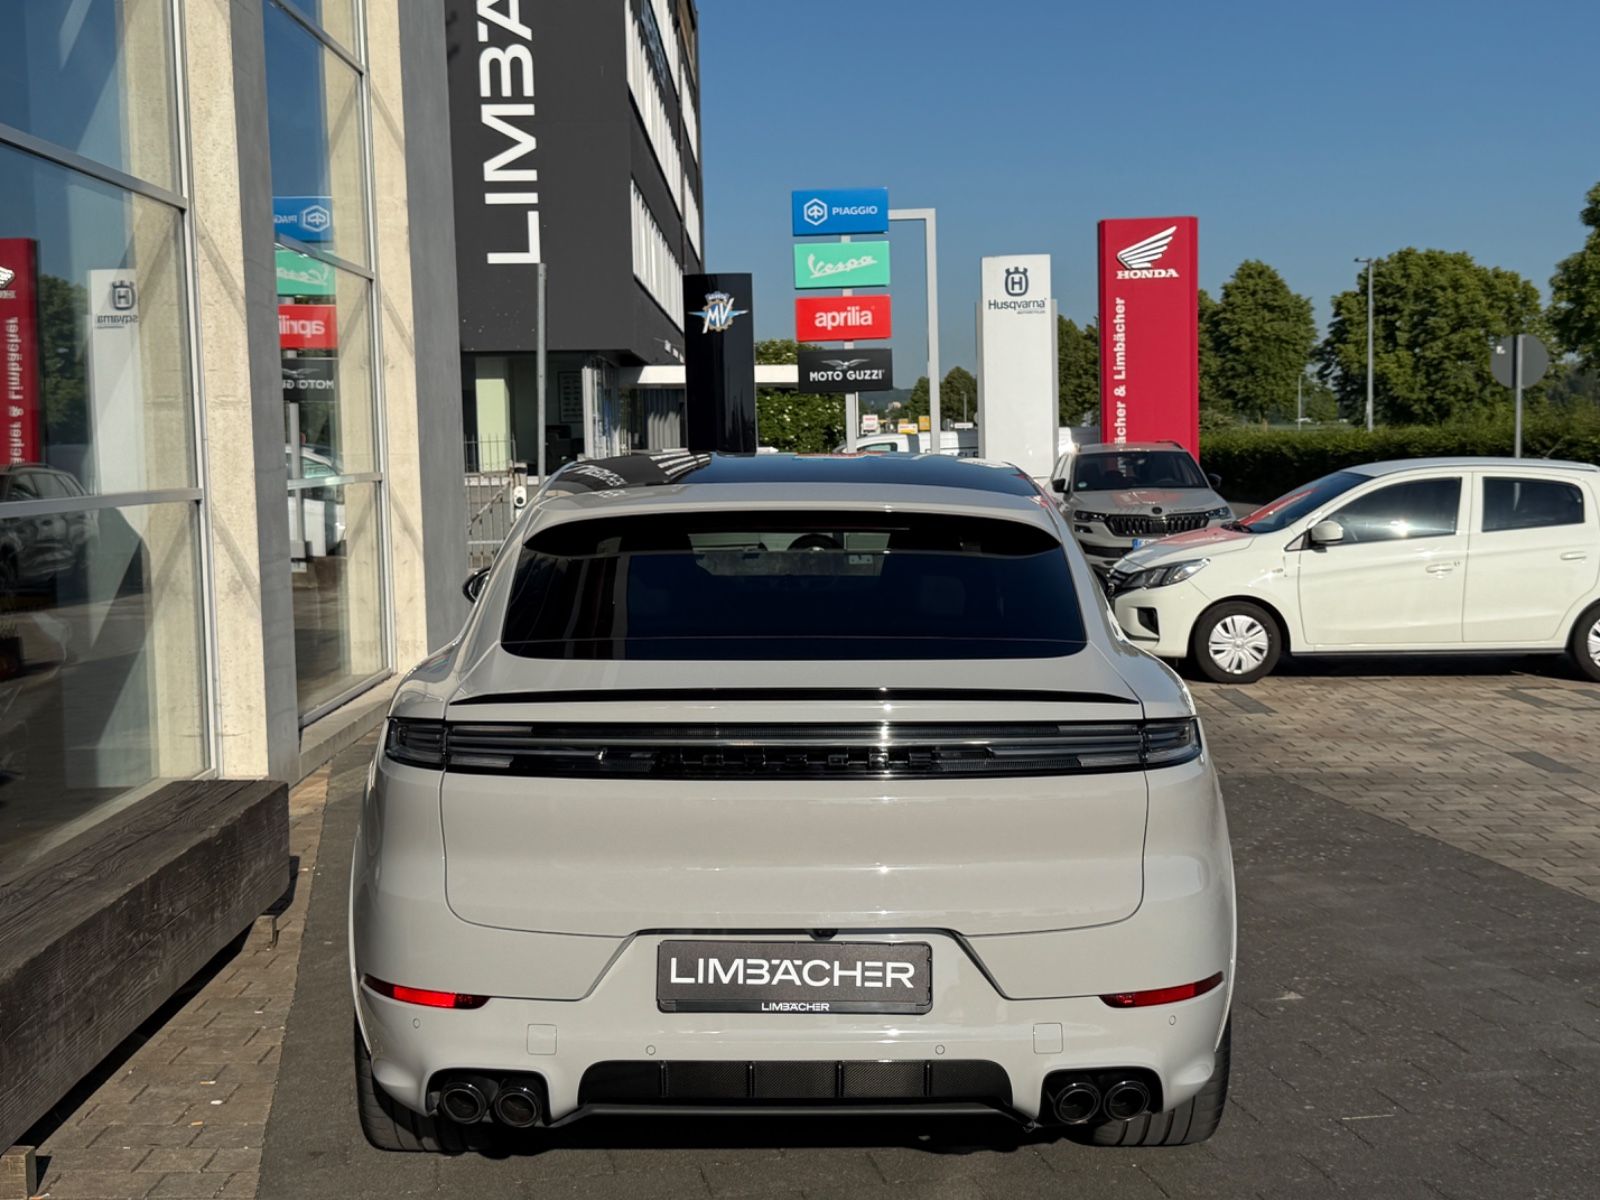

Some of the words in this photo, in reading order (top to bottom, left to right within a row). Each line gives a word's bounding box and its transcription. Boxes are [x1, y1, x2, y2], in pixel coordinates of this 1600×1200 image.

[832, 205, 878, 215] PIAGGIO
[807, 253, 878, 279] Vespa
[1116, 268, 1179, 280] HONDA
[988, 299, 1046, 311] Husqvarna
[814, 305, 873, 331] aprilia
[1113, 297, 1126, 380] Limbächer
[809, 371, 843, 382] MOTO
[846, 369, 883, 380] GUZZI
[1114, 385, 1127, 397] &
[670, 957, 915, 988] LIMBÄCHER
[761, 1002, 830, 1012] LIMBÄCHER
